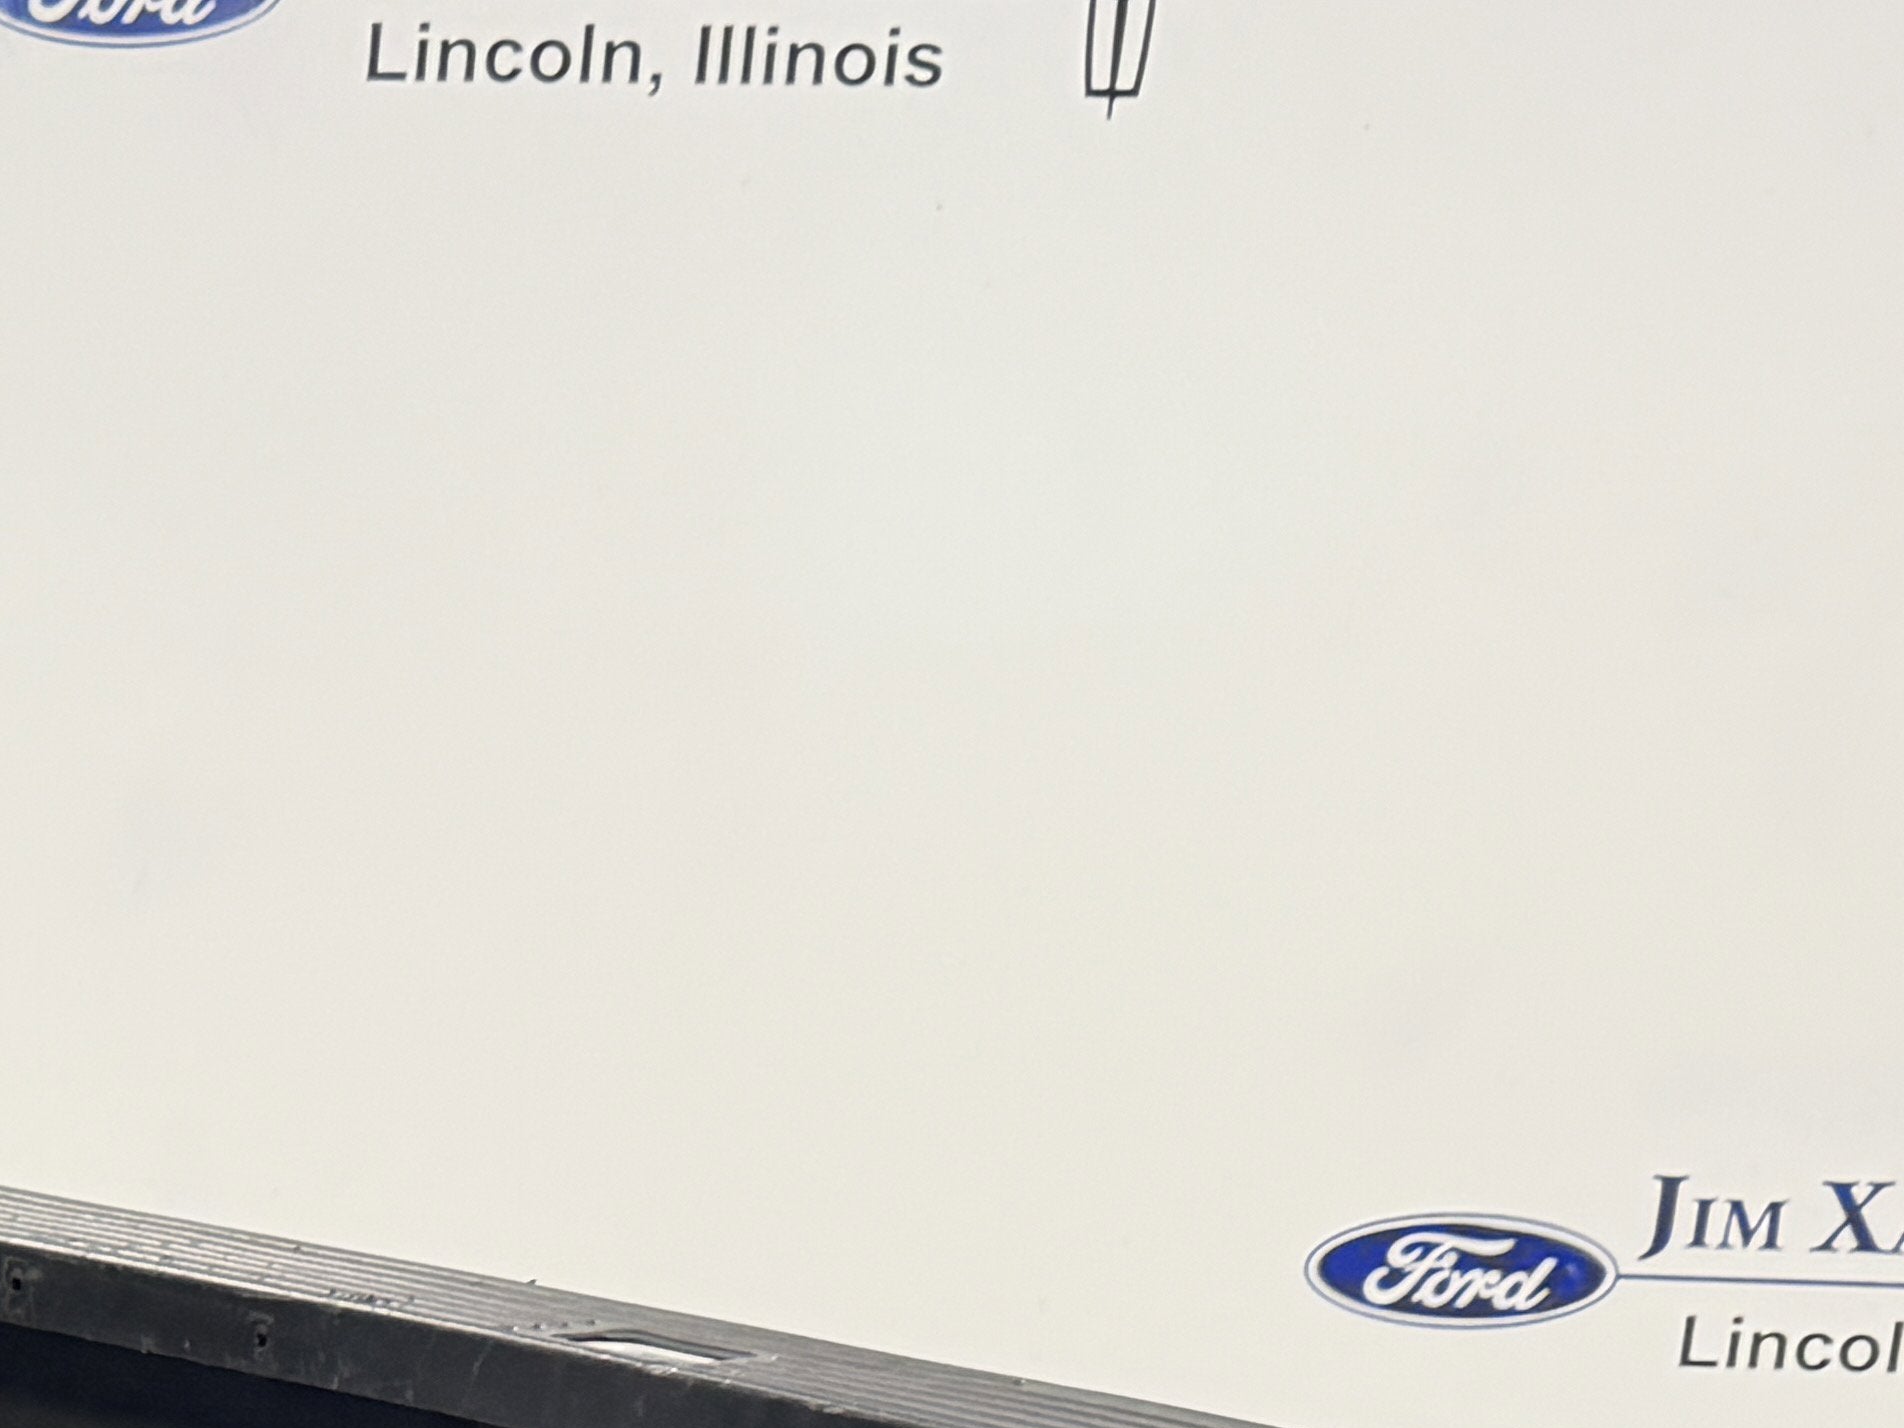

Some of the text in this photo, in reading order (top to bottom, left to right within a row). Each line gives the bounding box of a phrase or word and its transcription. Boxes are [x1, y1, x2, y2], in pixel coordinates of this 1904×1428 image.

[365, 21, 944, 96] Lincoln, Illinois
[1809, 1181, 1904, 1255] X
[1361, 1230, 1558, 1313] Ford
[1677, 1314, 1904, 1374] Lincol
